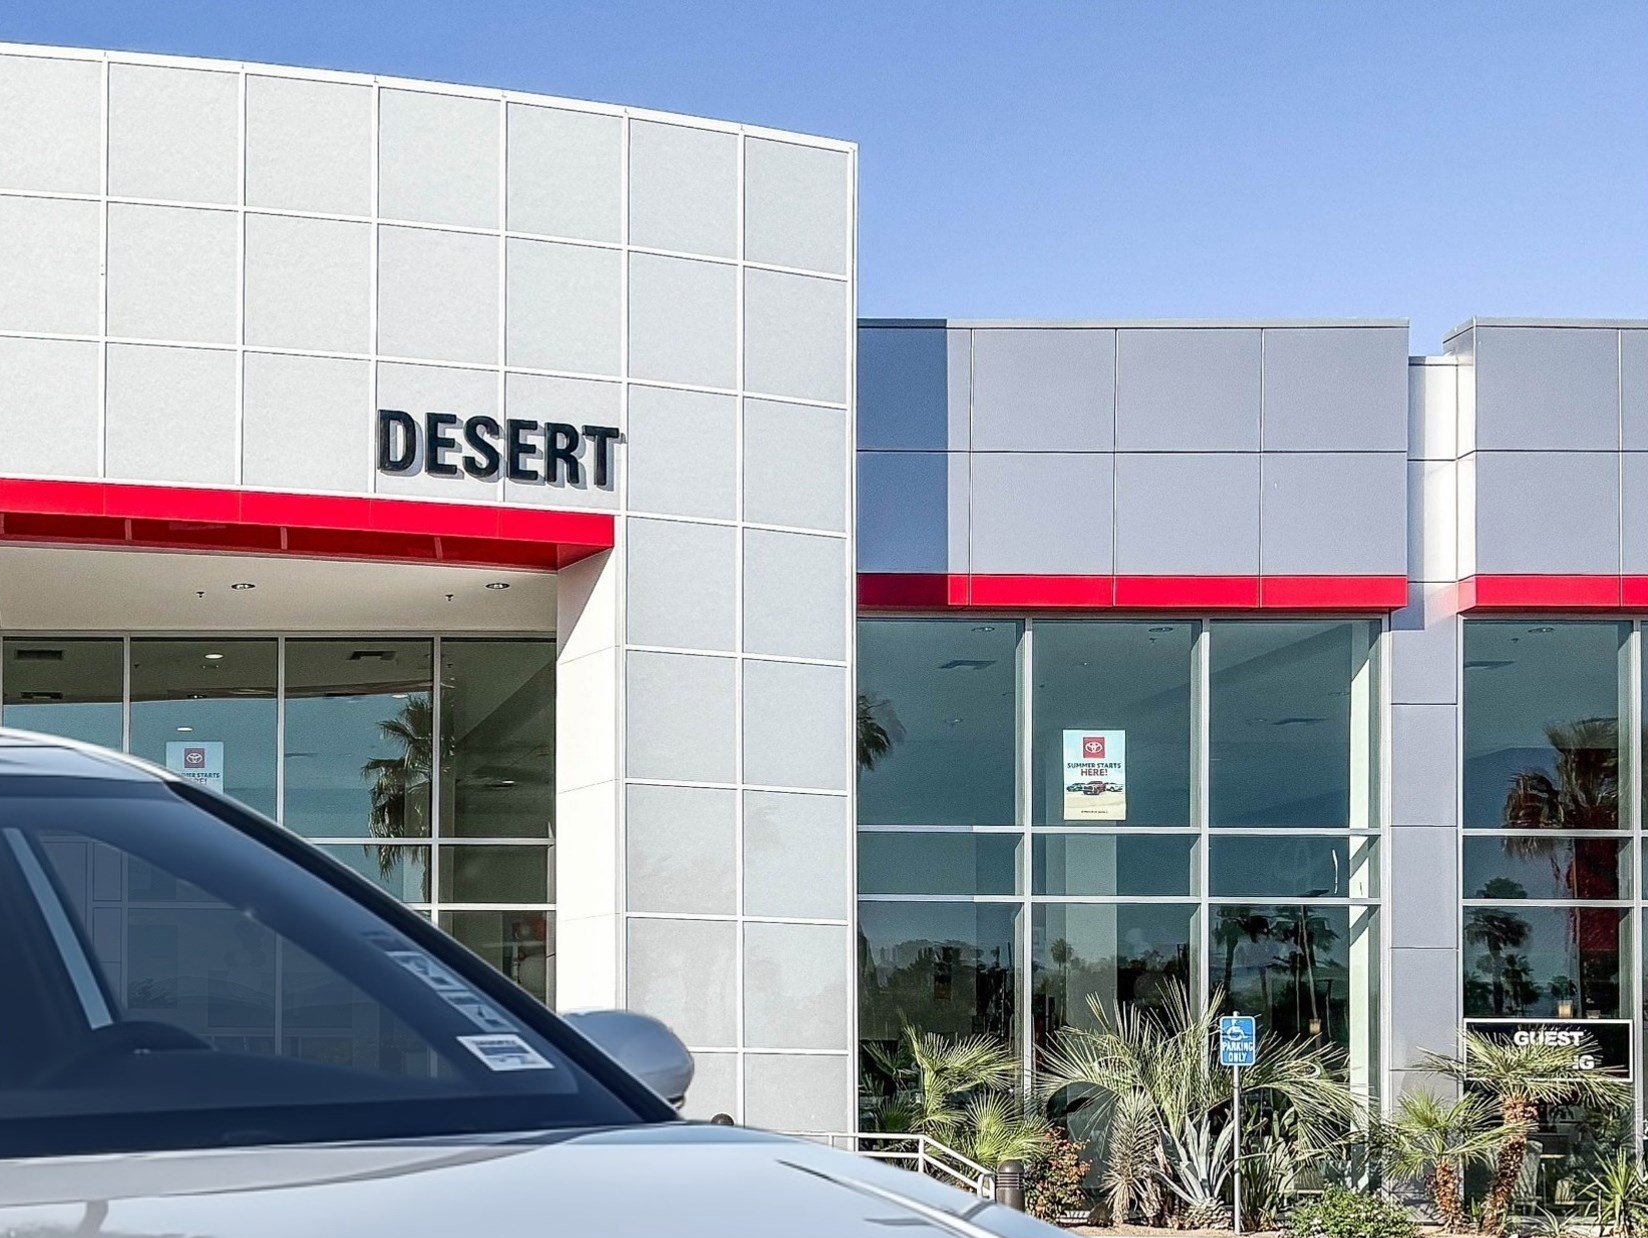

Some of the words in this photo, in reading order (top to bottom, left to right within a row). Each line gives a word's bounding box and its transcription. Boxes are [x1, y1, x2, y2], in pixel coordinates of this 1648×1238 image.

[376, 408, 620, 487] DESERT
[1080, 768, 1108, 776] HERE!
[1513, 1030, 1584, 1047] GUEST
[1221, 1040, 1253, 1051] PARKING
[1228, 1051, 1247, 1062] ONLY
